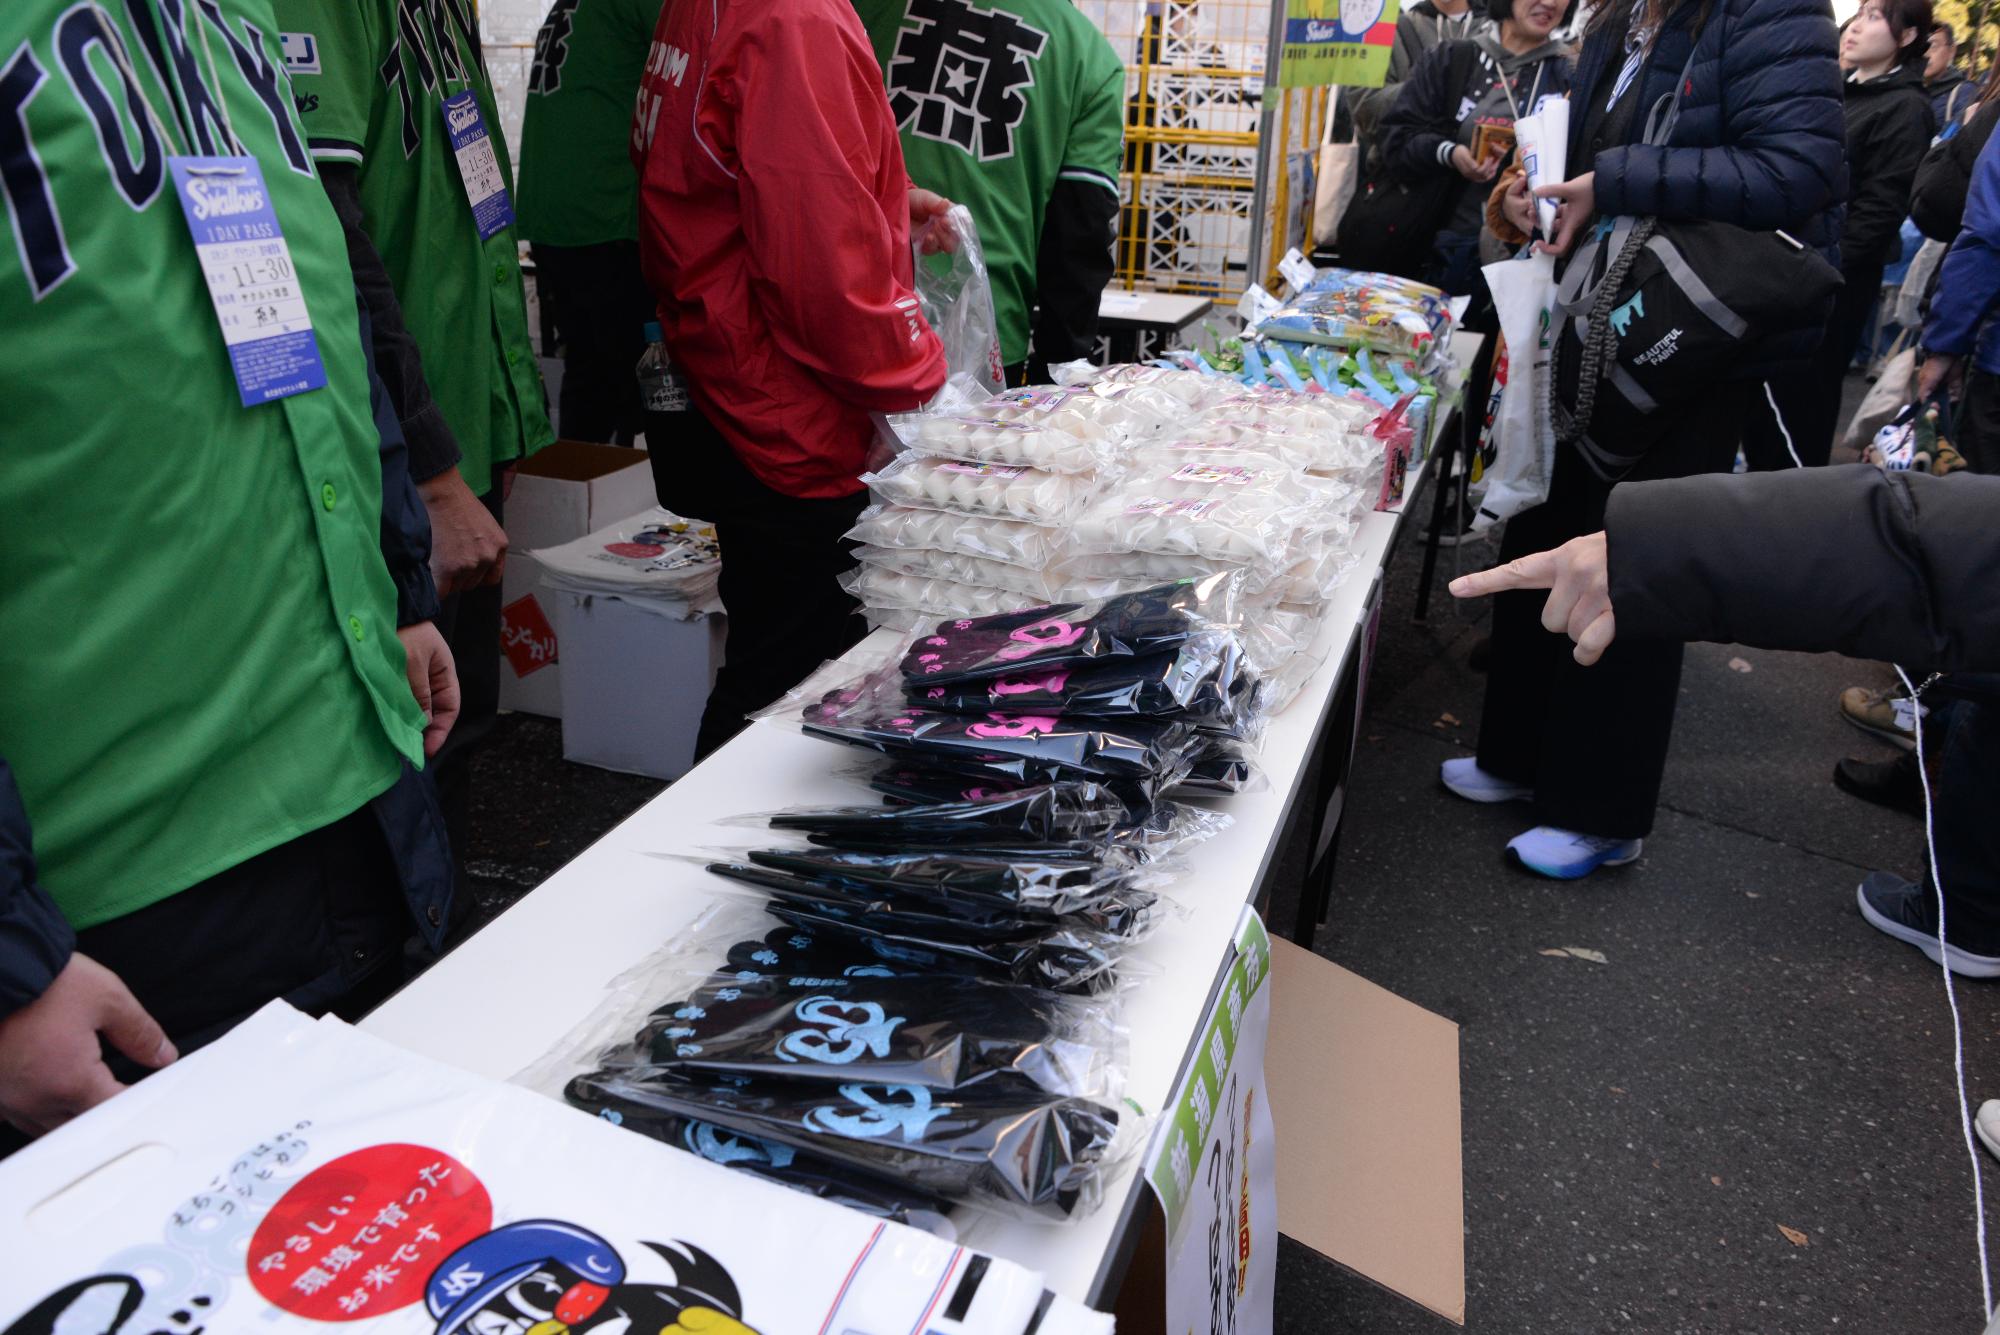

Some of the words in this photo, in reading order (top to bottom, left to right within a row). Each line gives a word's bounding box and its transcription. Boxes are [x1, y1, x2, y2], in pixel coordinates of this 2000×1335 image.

[448, 106, 479, 136] Swallows
[471, 128, 484, 141] PASS
[468, 149, 494, 173] 11-30
[186, 177, 264, 221] Swallows
[207, 228, 215, 242] 1
[216, 225, 241, 241] DAY
[243, 223, 274, 239] PASS
[232, 257, 290, 288] 11-30
[1633, 328, 1684, 366] BEAUTIFUL
[1649, 341, 1680, 366] PAINT
[219, 1139, 308, 1217] コシヒカリ
[258, 1194, 356, 1274] やさしい
[290, 1161, 453, 1296] 環境で育った
[337, 1222, 442, 1314] お米です
